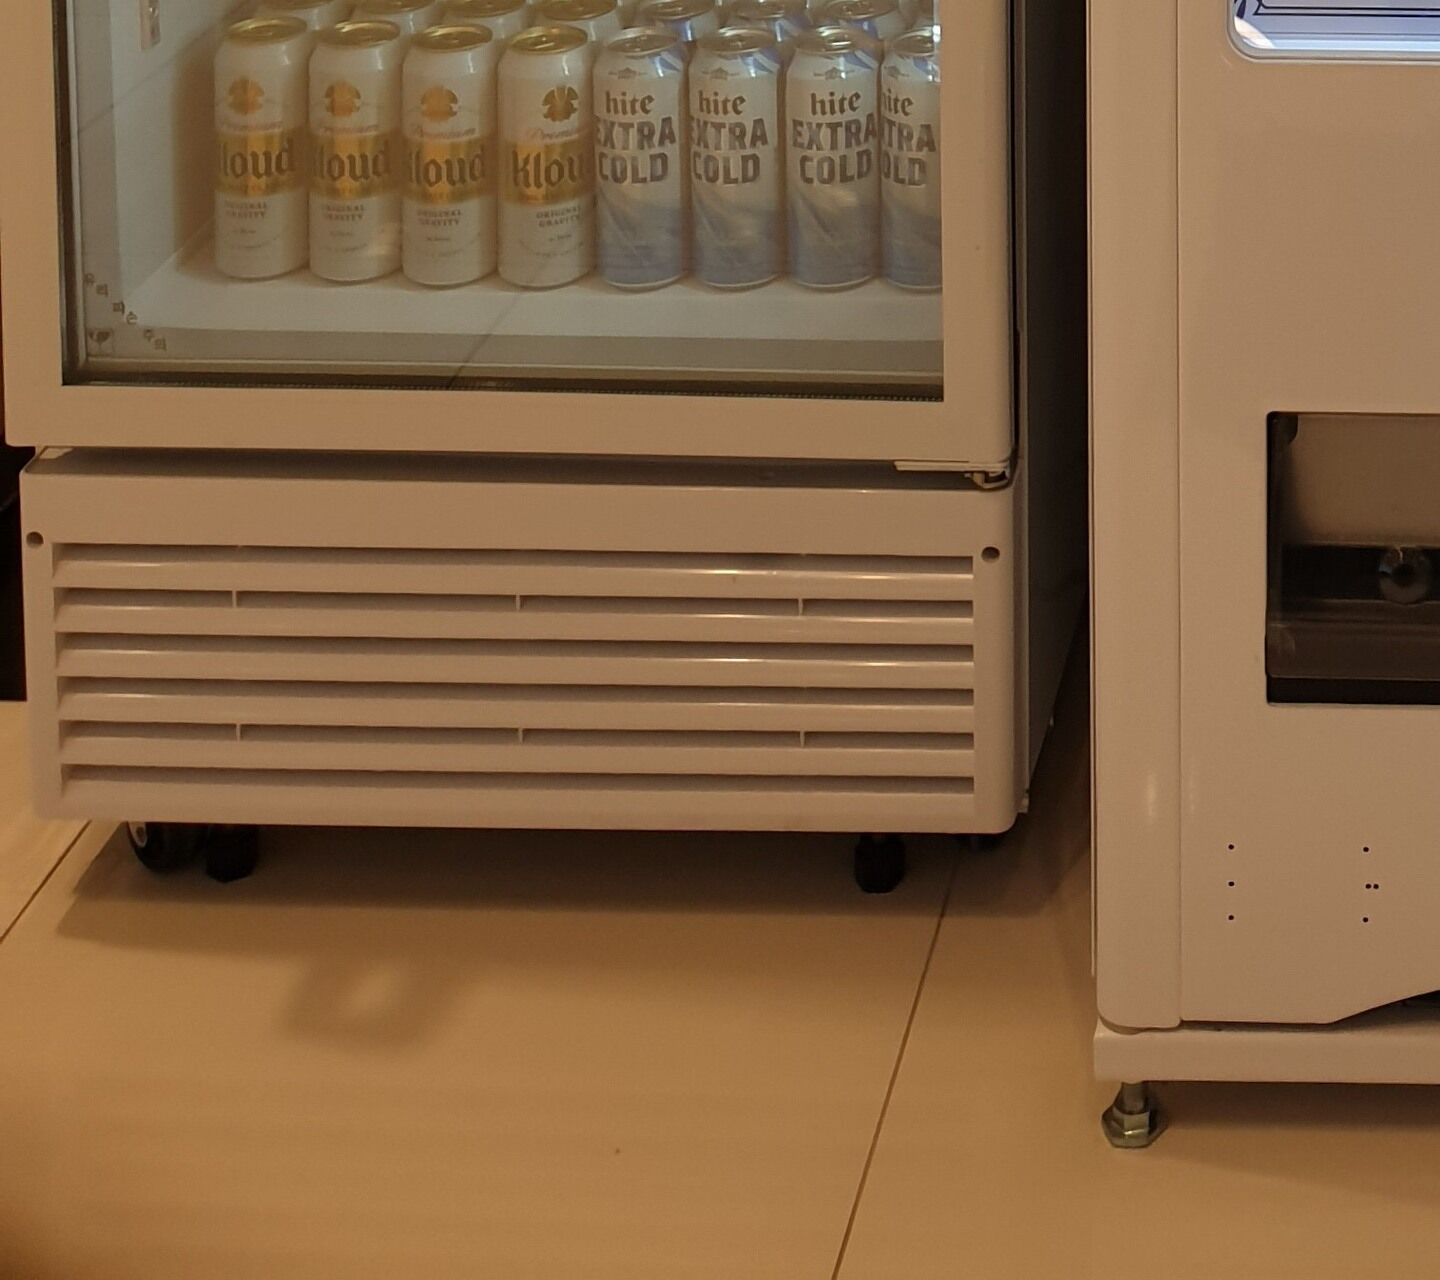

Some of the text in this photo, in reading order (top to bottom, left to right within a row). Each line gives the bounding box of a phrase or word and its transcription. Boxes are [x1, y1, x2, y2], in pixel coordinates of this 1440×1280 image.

[606, 92, 655, 115] hite
[810, 91, 861, 116] hite
[792, 112, 877, 152] EXTRA
[600, 152, 668, 184] COLD
[800, 149, 872, 184] COLD
